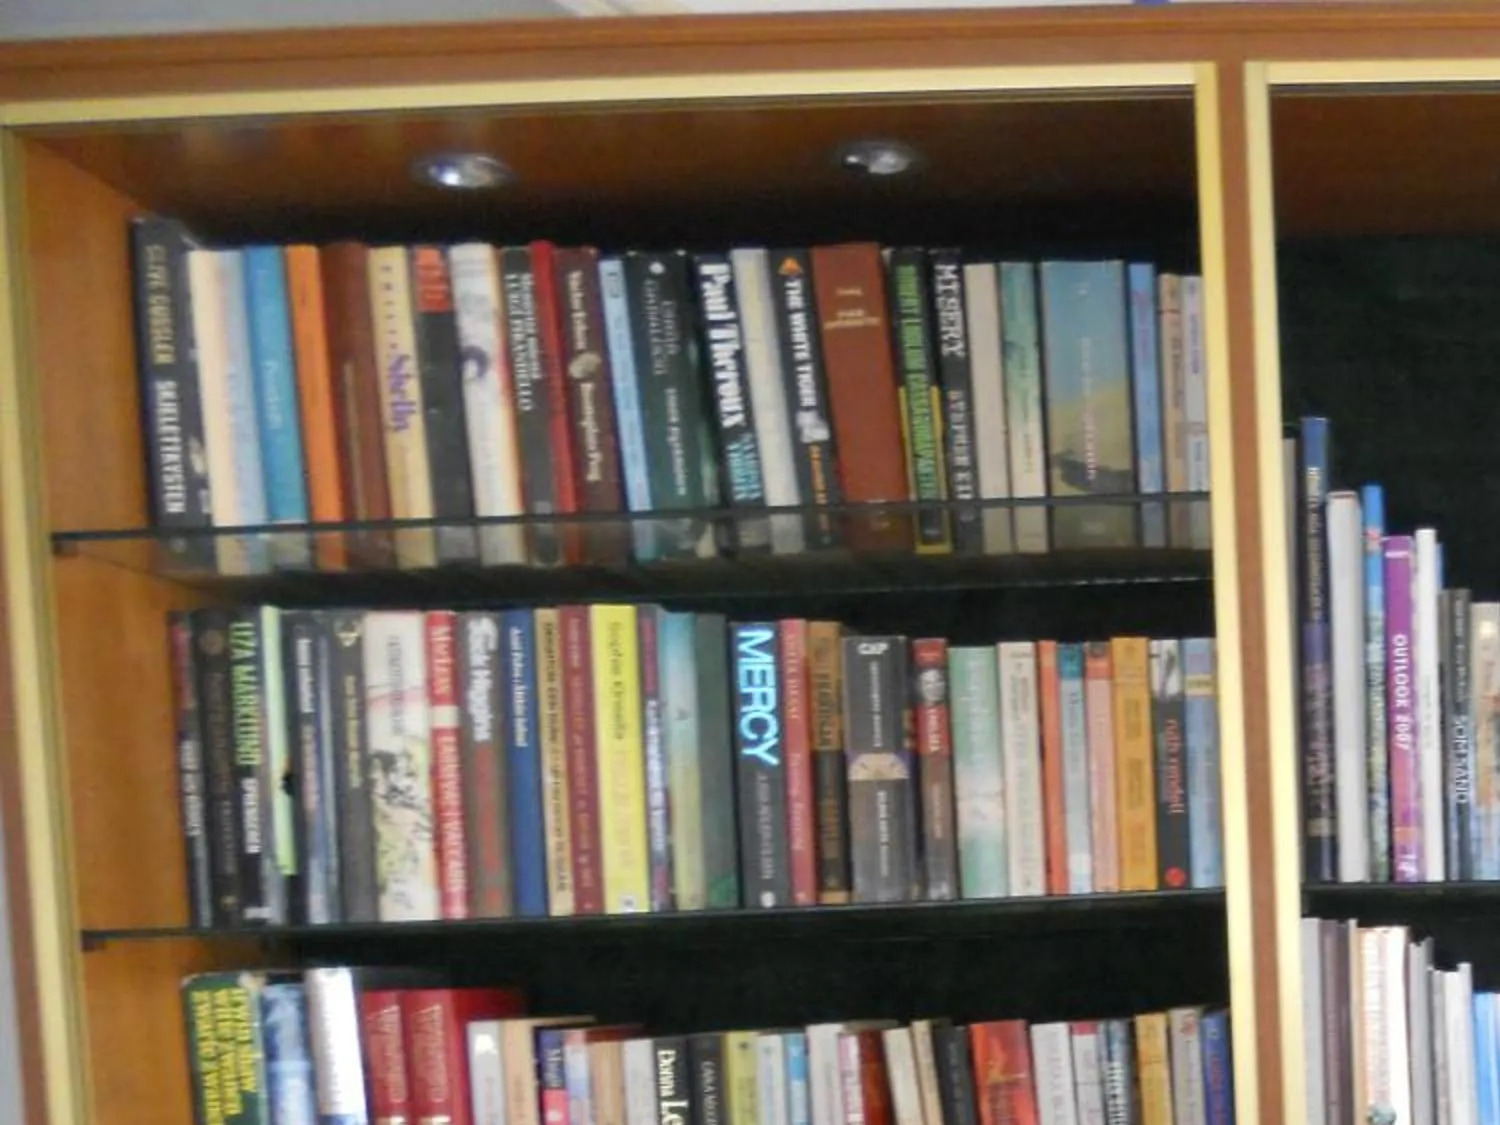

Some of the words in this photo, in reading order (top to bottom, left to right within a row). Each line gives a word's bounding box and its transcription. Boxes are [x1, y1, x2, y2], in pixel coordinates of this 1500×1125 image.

[699, 263, 737, 321] Paul
[783, 280, 805, 309] THE
[933, 263, 967, 359] MISERY
[788, 312, 811, 362] WHITE
[709, 325, 748, 429] Theroux
[793, 365, 818, 409] TIGER
[229, 621, 258, 661] LIZA
[1392, 633, 1409, 708] OUTLOOK
[230, 664, 263, 766] MARKLUND
[737, 628, 779, 766] MERCY
[1164, 718, 1182, 753] ruth
[1394, 714, 1412, 752] 2007
[1165, 757, 1184, 814] rendell
[1454, 757, 1470, 804] SAND
[656, 1049, 679, 1098] Donna
